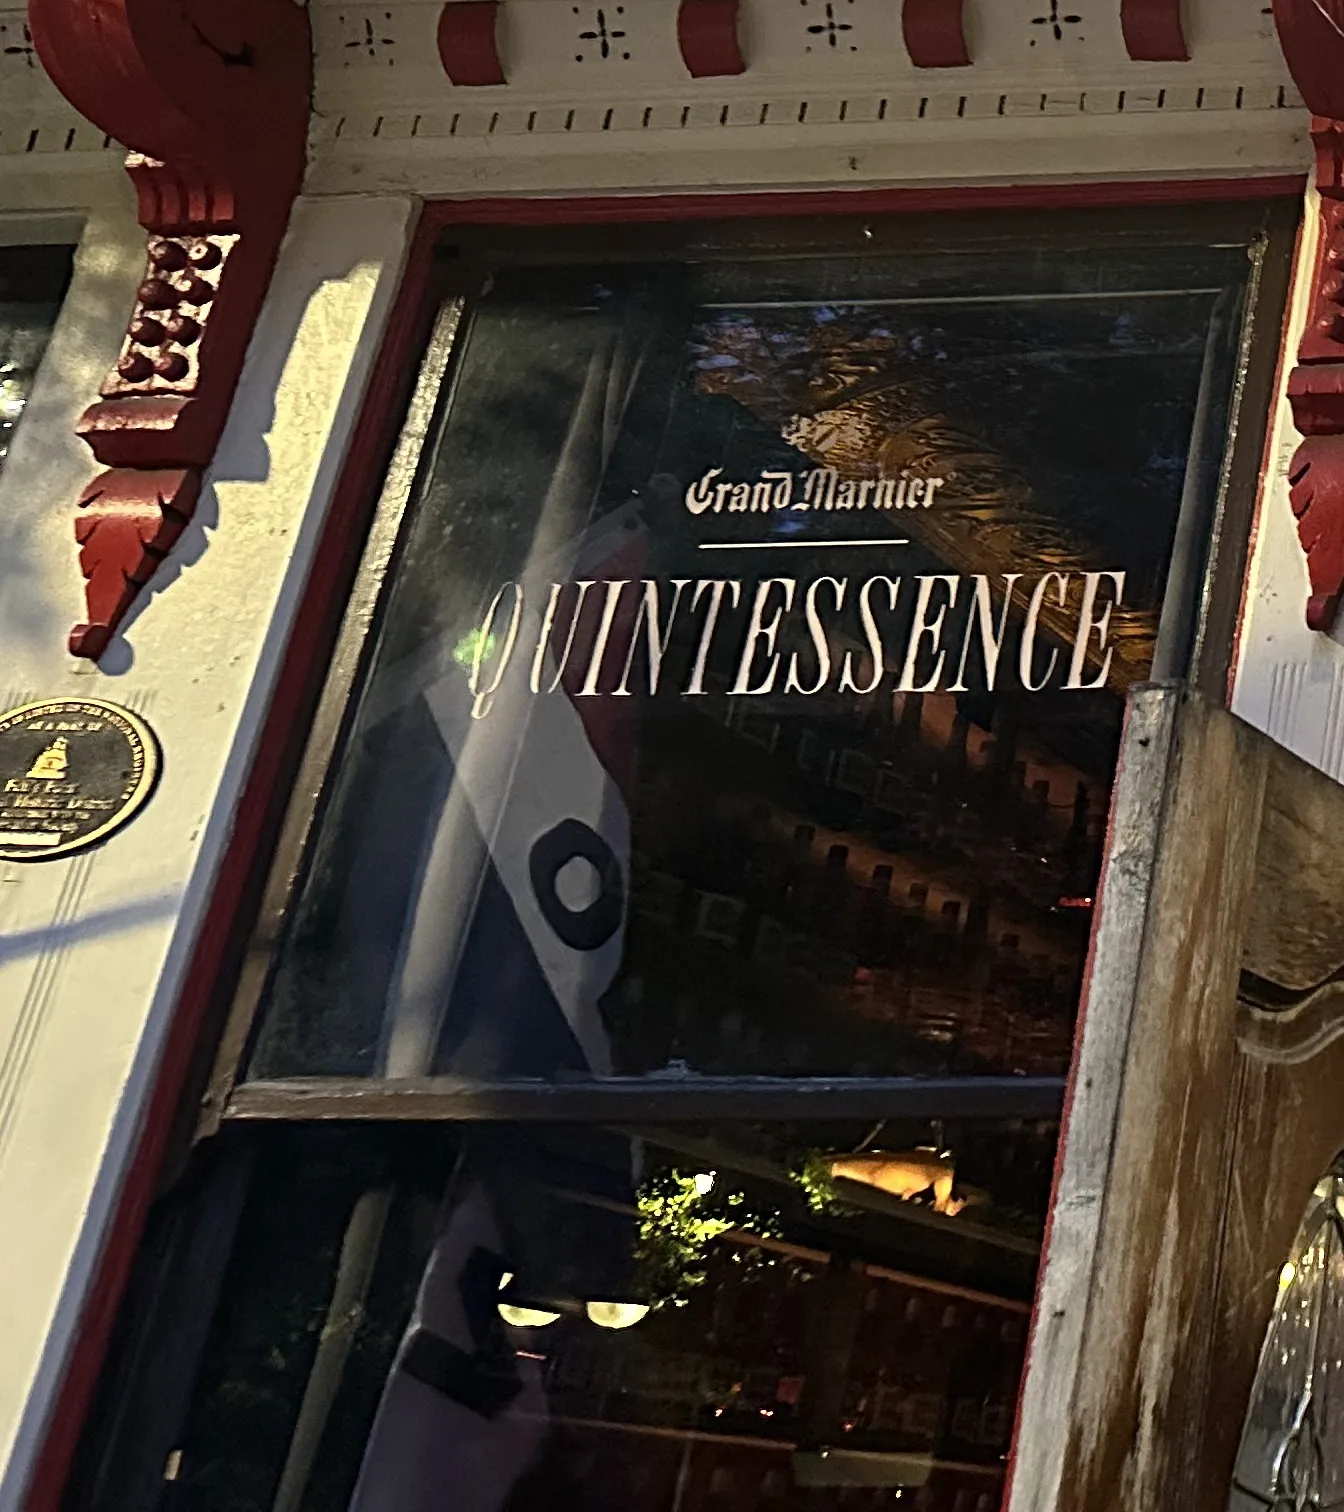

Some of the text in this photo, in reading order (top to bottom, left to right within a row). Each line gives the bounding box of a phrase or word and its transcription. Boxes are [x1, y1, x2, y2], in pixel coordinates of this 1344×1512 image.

[685, 467, 945, 515] Grand Marnier
[467, 569, 1128, 720] QUINTESSENCE
